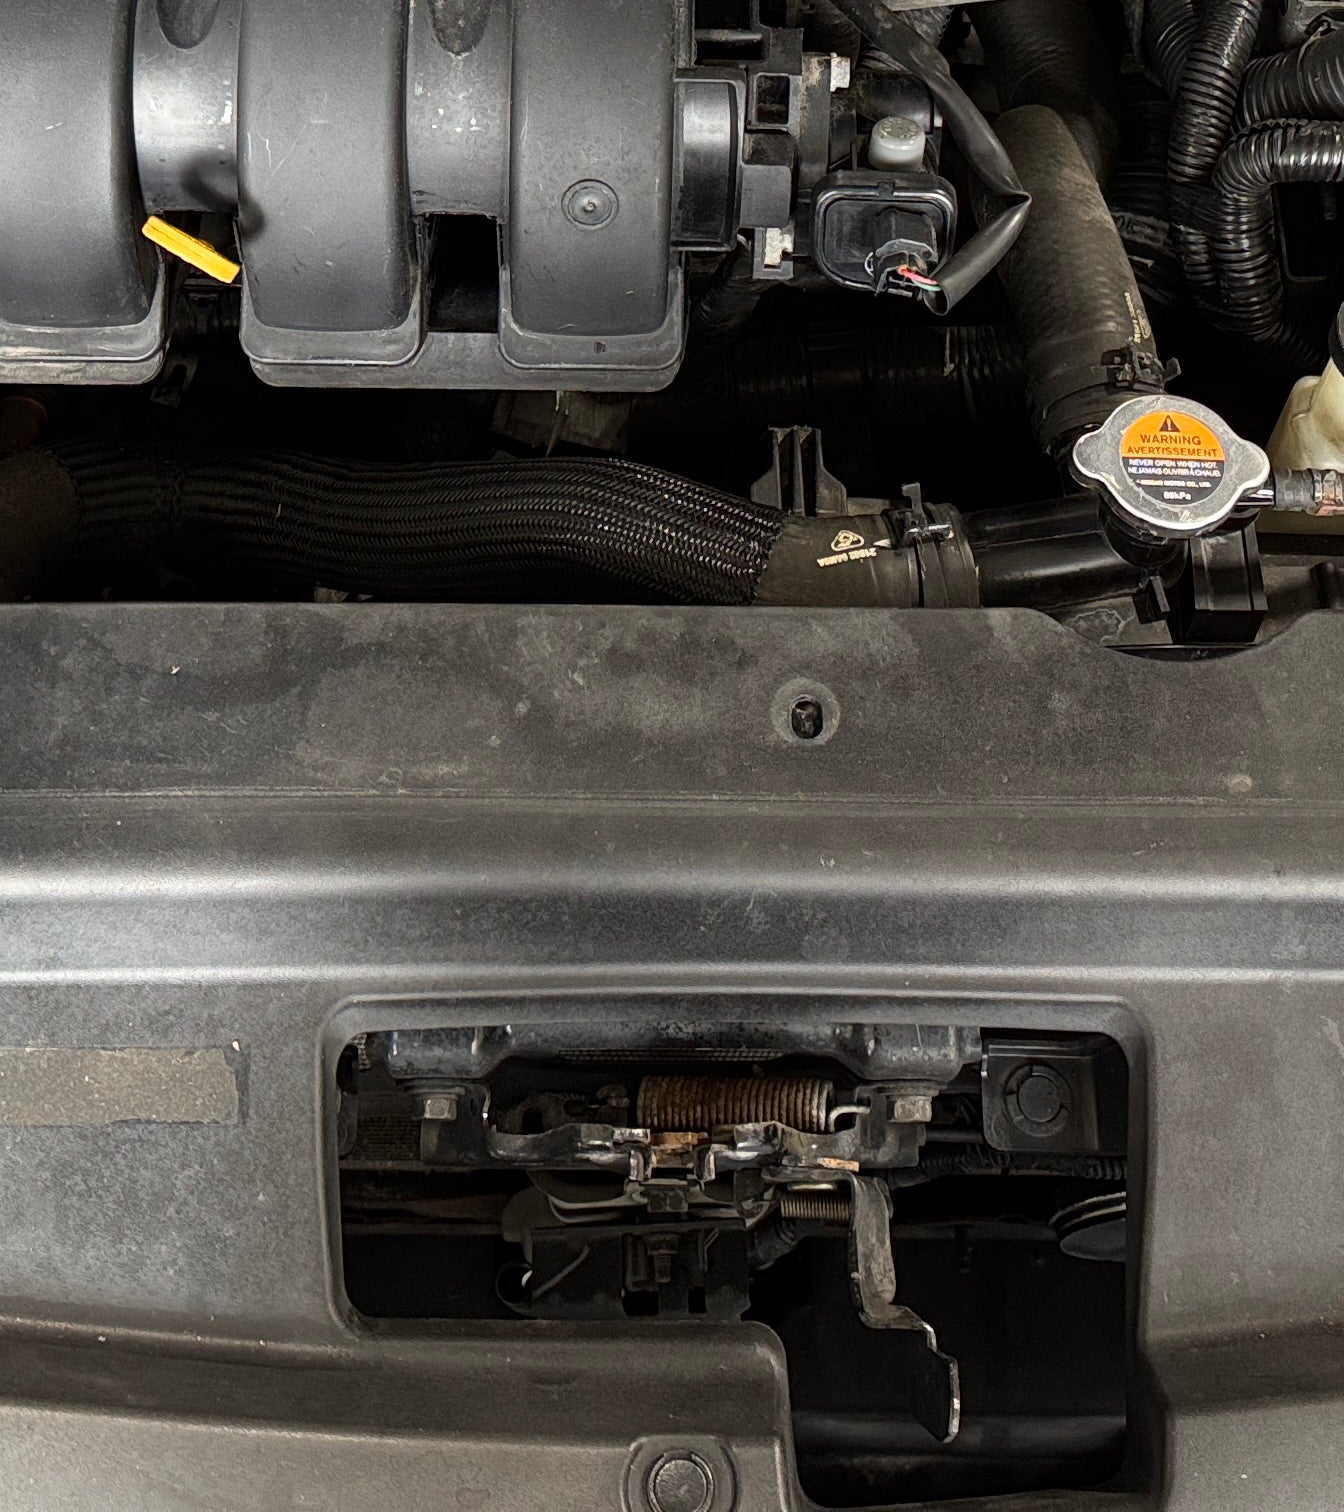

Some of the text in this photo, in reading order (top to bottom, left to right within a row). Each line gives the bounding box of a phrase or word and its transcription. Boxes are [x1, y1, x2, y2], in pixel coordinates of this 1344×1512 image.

[1140, 434, 1202, 446] WARNING
[1127, 446, 1218, 457] AVERTISSEMENT
[1201, 461, 1218, 469] HOT.
